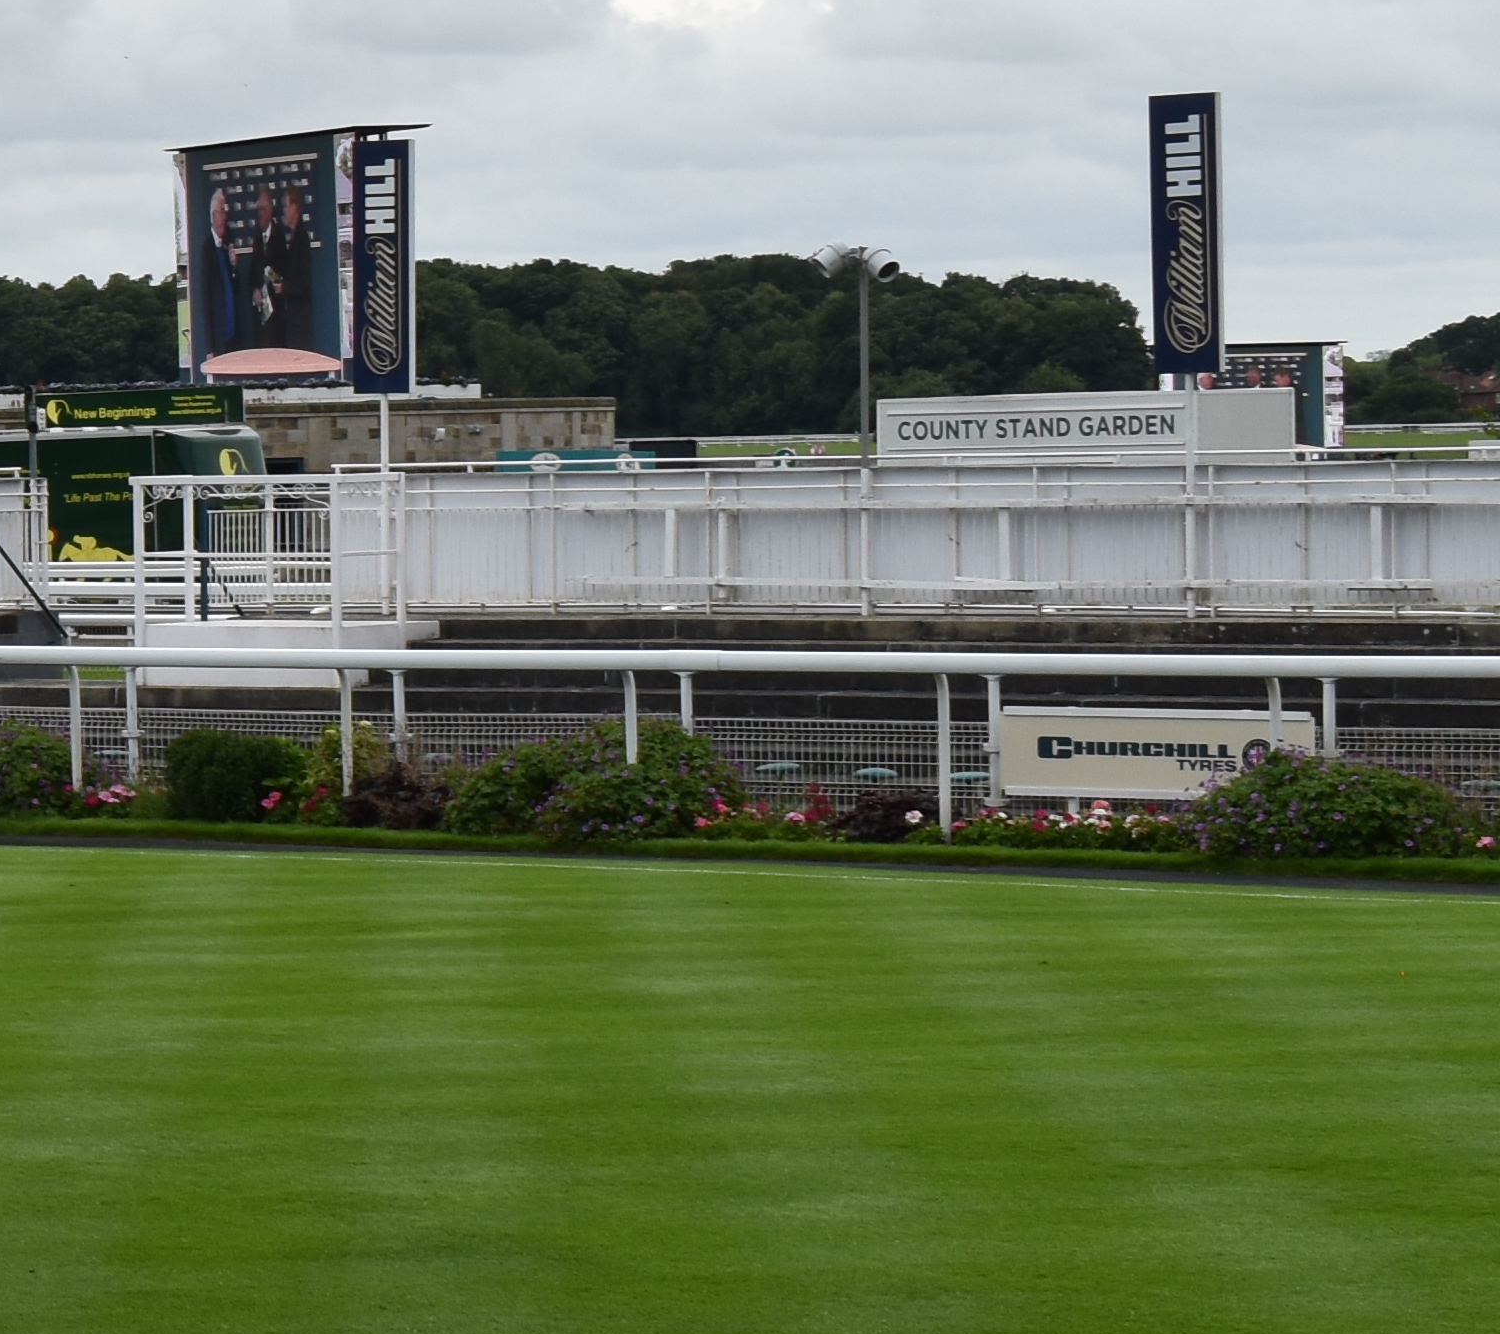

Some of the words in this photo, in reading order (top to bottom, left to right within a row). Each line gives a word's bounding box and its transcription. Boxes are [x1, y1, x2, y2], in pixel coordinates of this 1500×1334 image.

[1165, 114, 1202, 197] HILL
[365, 158, 396, 234] HILL
[1164, 200, 1211, 353] William
[361, 236, 400, 375] William
[74, 409, 97, 420] New
[99, 406, 157, 421] Beginnings
[897, 419, 988, 441] COUNTY
[995, 417, 1071, 439] STAND
[1078, 414, 1175, 437] GARDEN
[1037, 736, 1237, 759] CHURCHILL
[1175, 759, 1237, 773] TYRES
